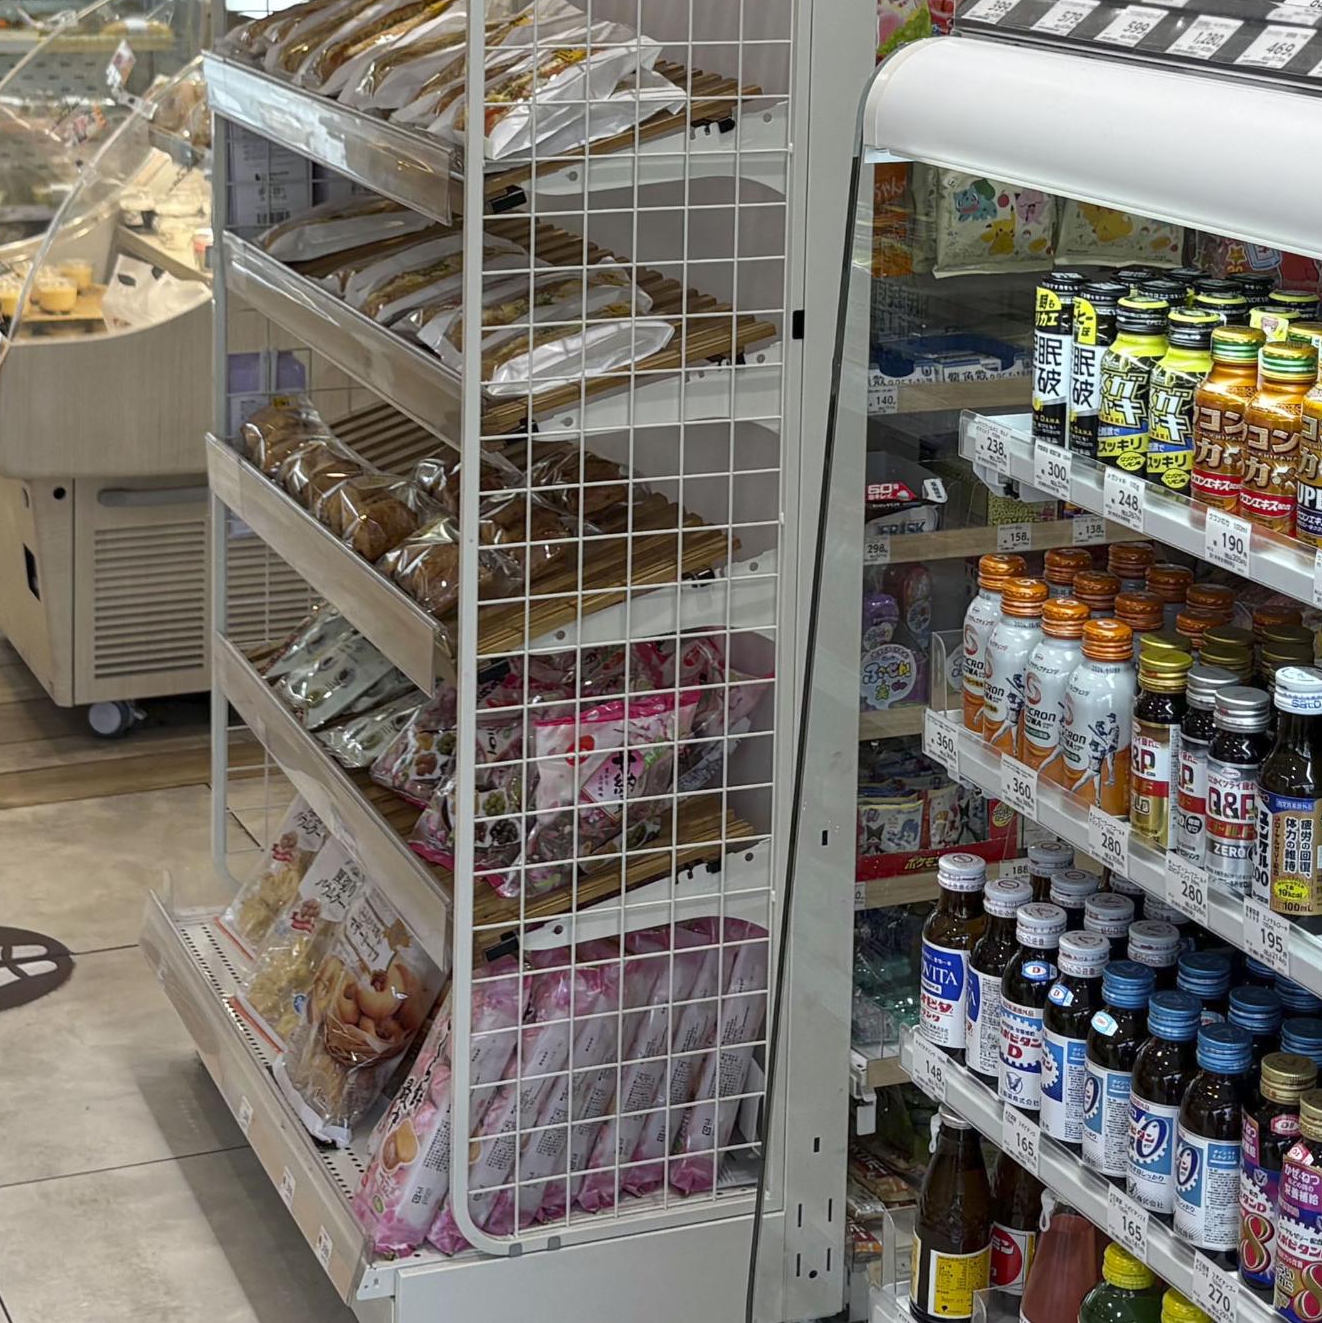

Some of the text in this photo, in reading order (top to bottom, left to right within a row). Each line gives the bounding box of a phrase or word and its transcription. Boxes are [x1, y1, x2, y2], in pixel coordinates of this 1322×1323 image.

[1098, 437, 1143, 452] スッキリ
[1291, 698, 1321, 710] sato
[1214, 843, 1246, 859] ZERO
[1284, 817, 1299, 873] 体力の維持
